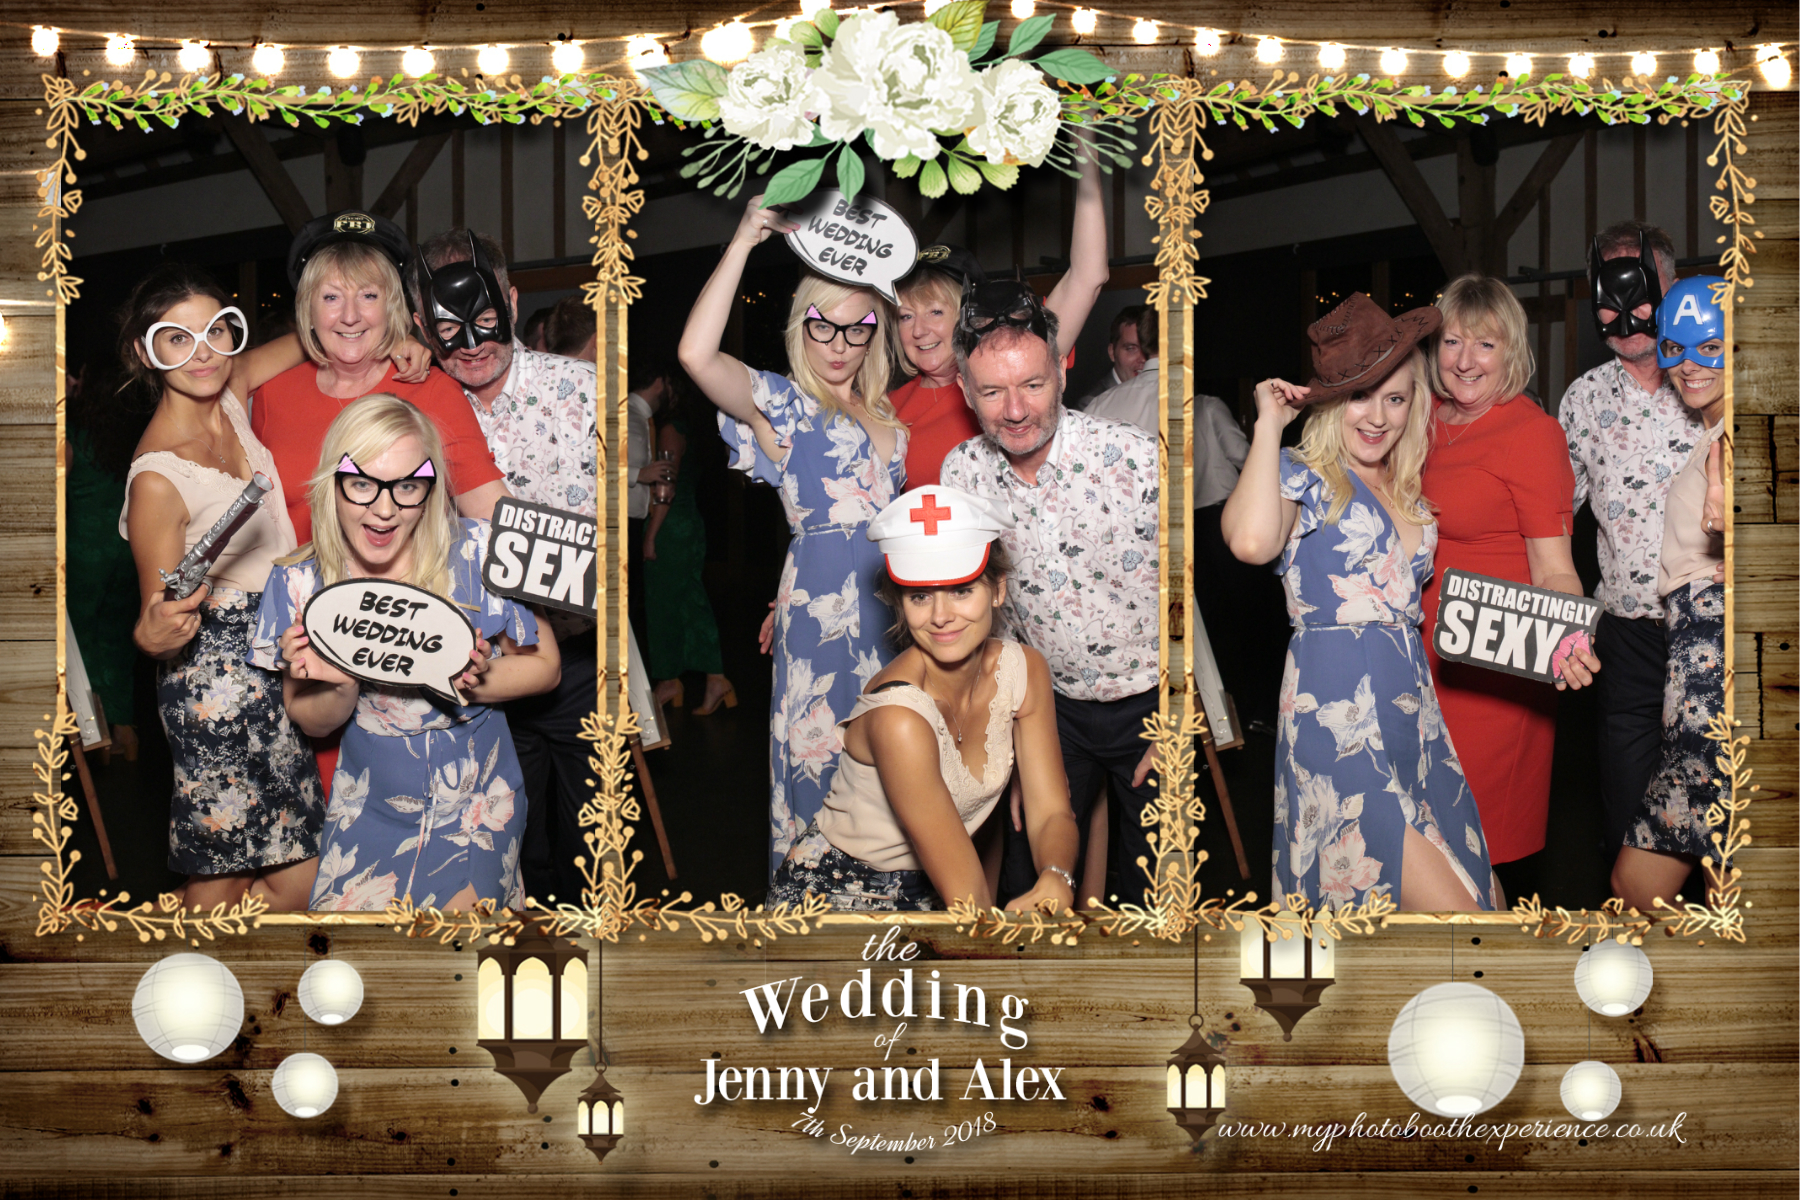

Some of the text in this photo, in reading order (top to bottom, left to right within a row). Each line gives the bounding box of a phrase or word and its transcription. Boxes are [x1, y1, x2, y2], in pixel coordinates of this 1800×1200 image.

[833, 198, 888, 229] BEST
[807, 215, 894, 259] WEDDING
[818, 246, 868, 277] EVER
[1672, 294, 1704, 326] A
[488, 531, 598, 610] SEX
[359, 591, 428, 620] BEST
[1446, 574, 1598, 627] DISTRACTINGLY
[333, 613, 443, 653] WEDDING
[1438, 600, 1567, 675] SEXY
[351, 647, 415, 677] EVER
